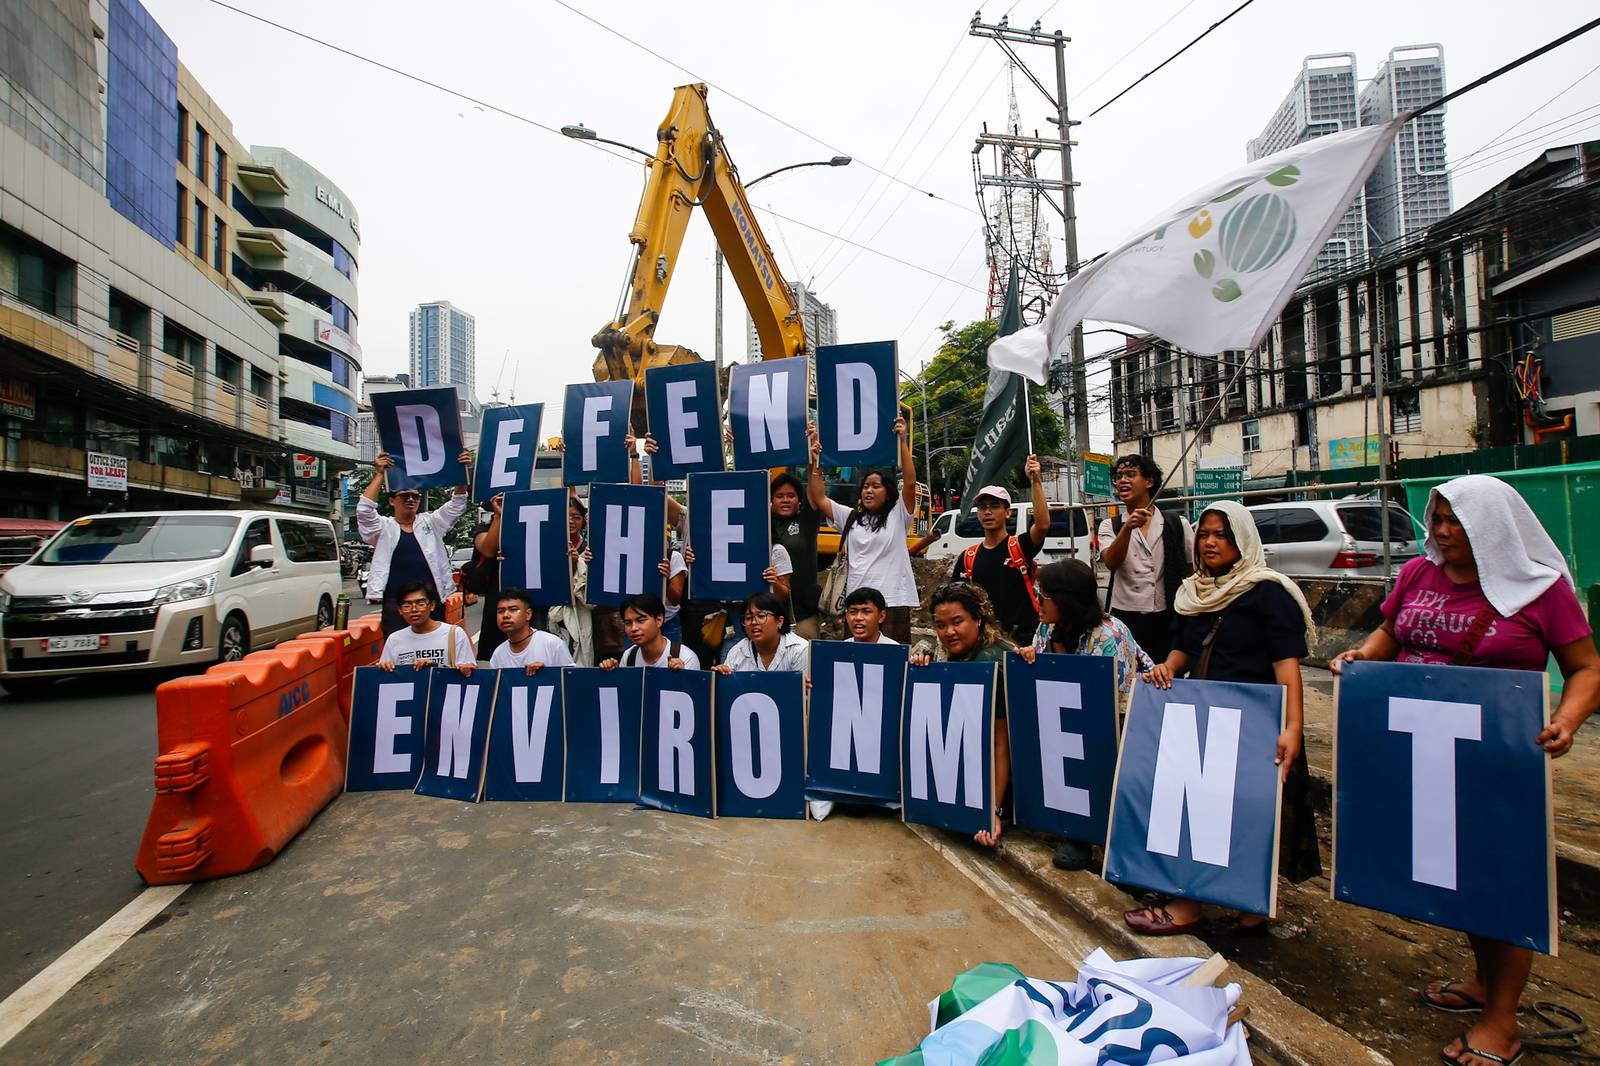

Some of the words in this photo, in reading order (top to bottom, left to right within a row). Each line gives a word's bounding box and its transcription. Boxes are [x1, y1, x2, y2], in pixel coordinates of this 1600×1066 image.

[732, 201, 774, 290] KOMATSU
[296, 455, 316, 478] 7
[395, 362, 878, 489] DEFEND
[91, 466, 104, 476] FOR
[105, 467, 126, 478] LEASE
[518, 489, 746, 595] THE
[415, 648, 445, 659] RESIST
[373, 661, 1481, 891] ENVIRONMENT
